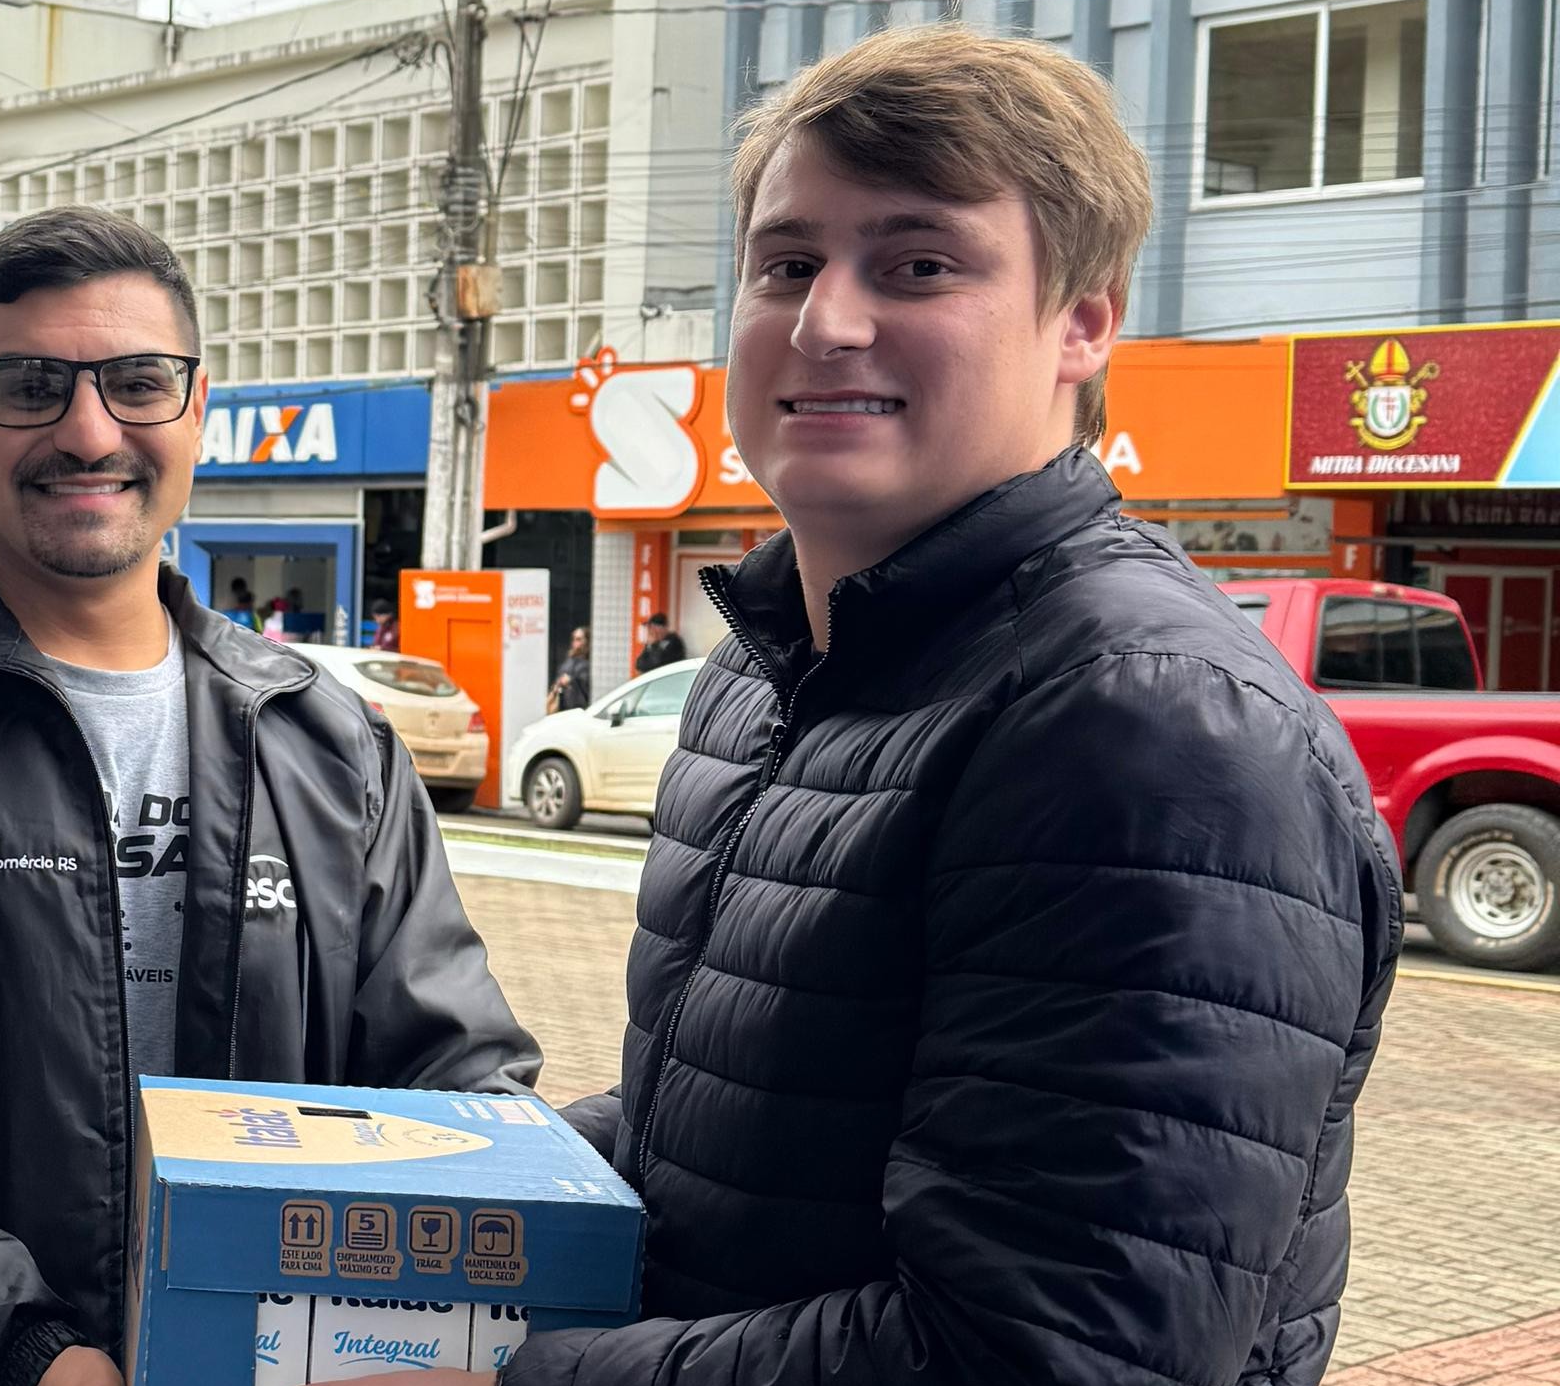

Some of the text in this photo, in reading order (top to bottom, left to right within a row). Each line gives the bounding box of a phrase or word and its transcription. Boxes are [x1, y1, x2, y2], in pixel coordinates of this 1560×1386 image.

[198, 403, 337, 465] AIXA
[1310, 454, 1462, 474] MITRA DIOCESANA
[58, 856, 78, 871] RS
[359, 1213, 376, 1231] 5
[282, 1250, 322, 1260] ESTE LADO
[337, 1252, 395, 1264] EMPILHAMENTO
[281, 1261, 322, 1271] PARA CIMA
[340, 1262, 372, 1274] MÁXIMO
[374, 1265, 379, 1274] 5
[416, 1258, 443, 1269] FRÁGIL
[465, 1259, 506, 1270] MANTENHA
[469, 1271, 515, 1281] LOCAL SECO
[334, 1330, 440, 1362] Integral
